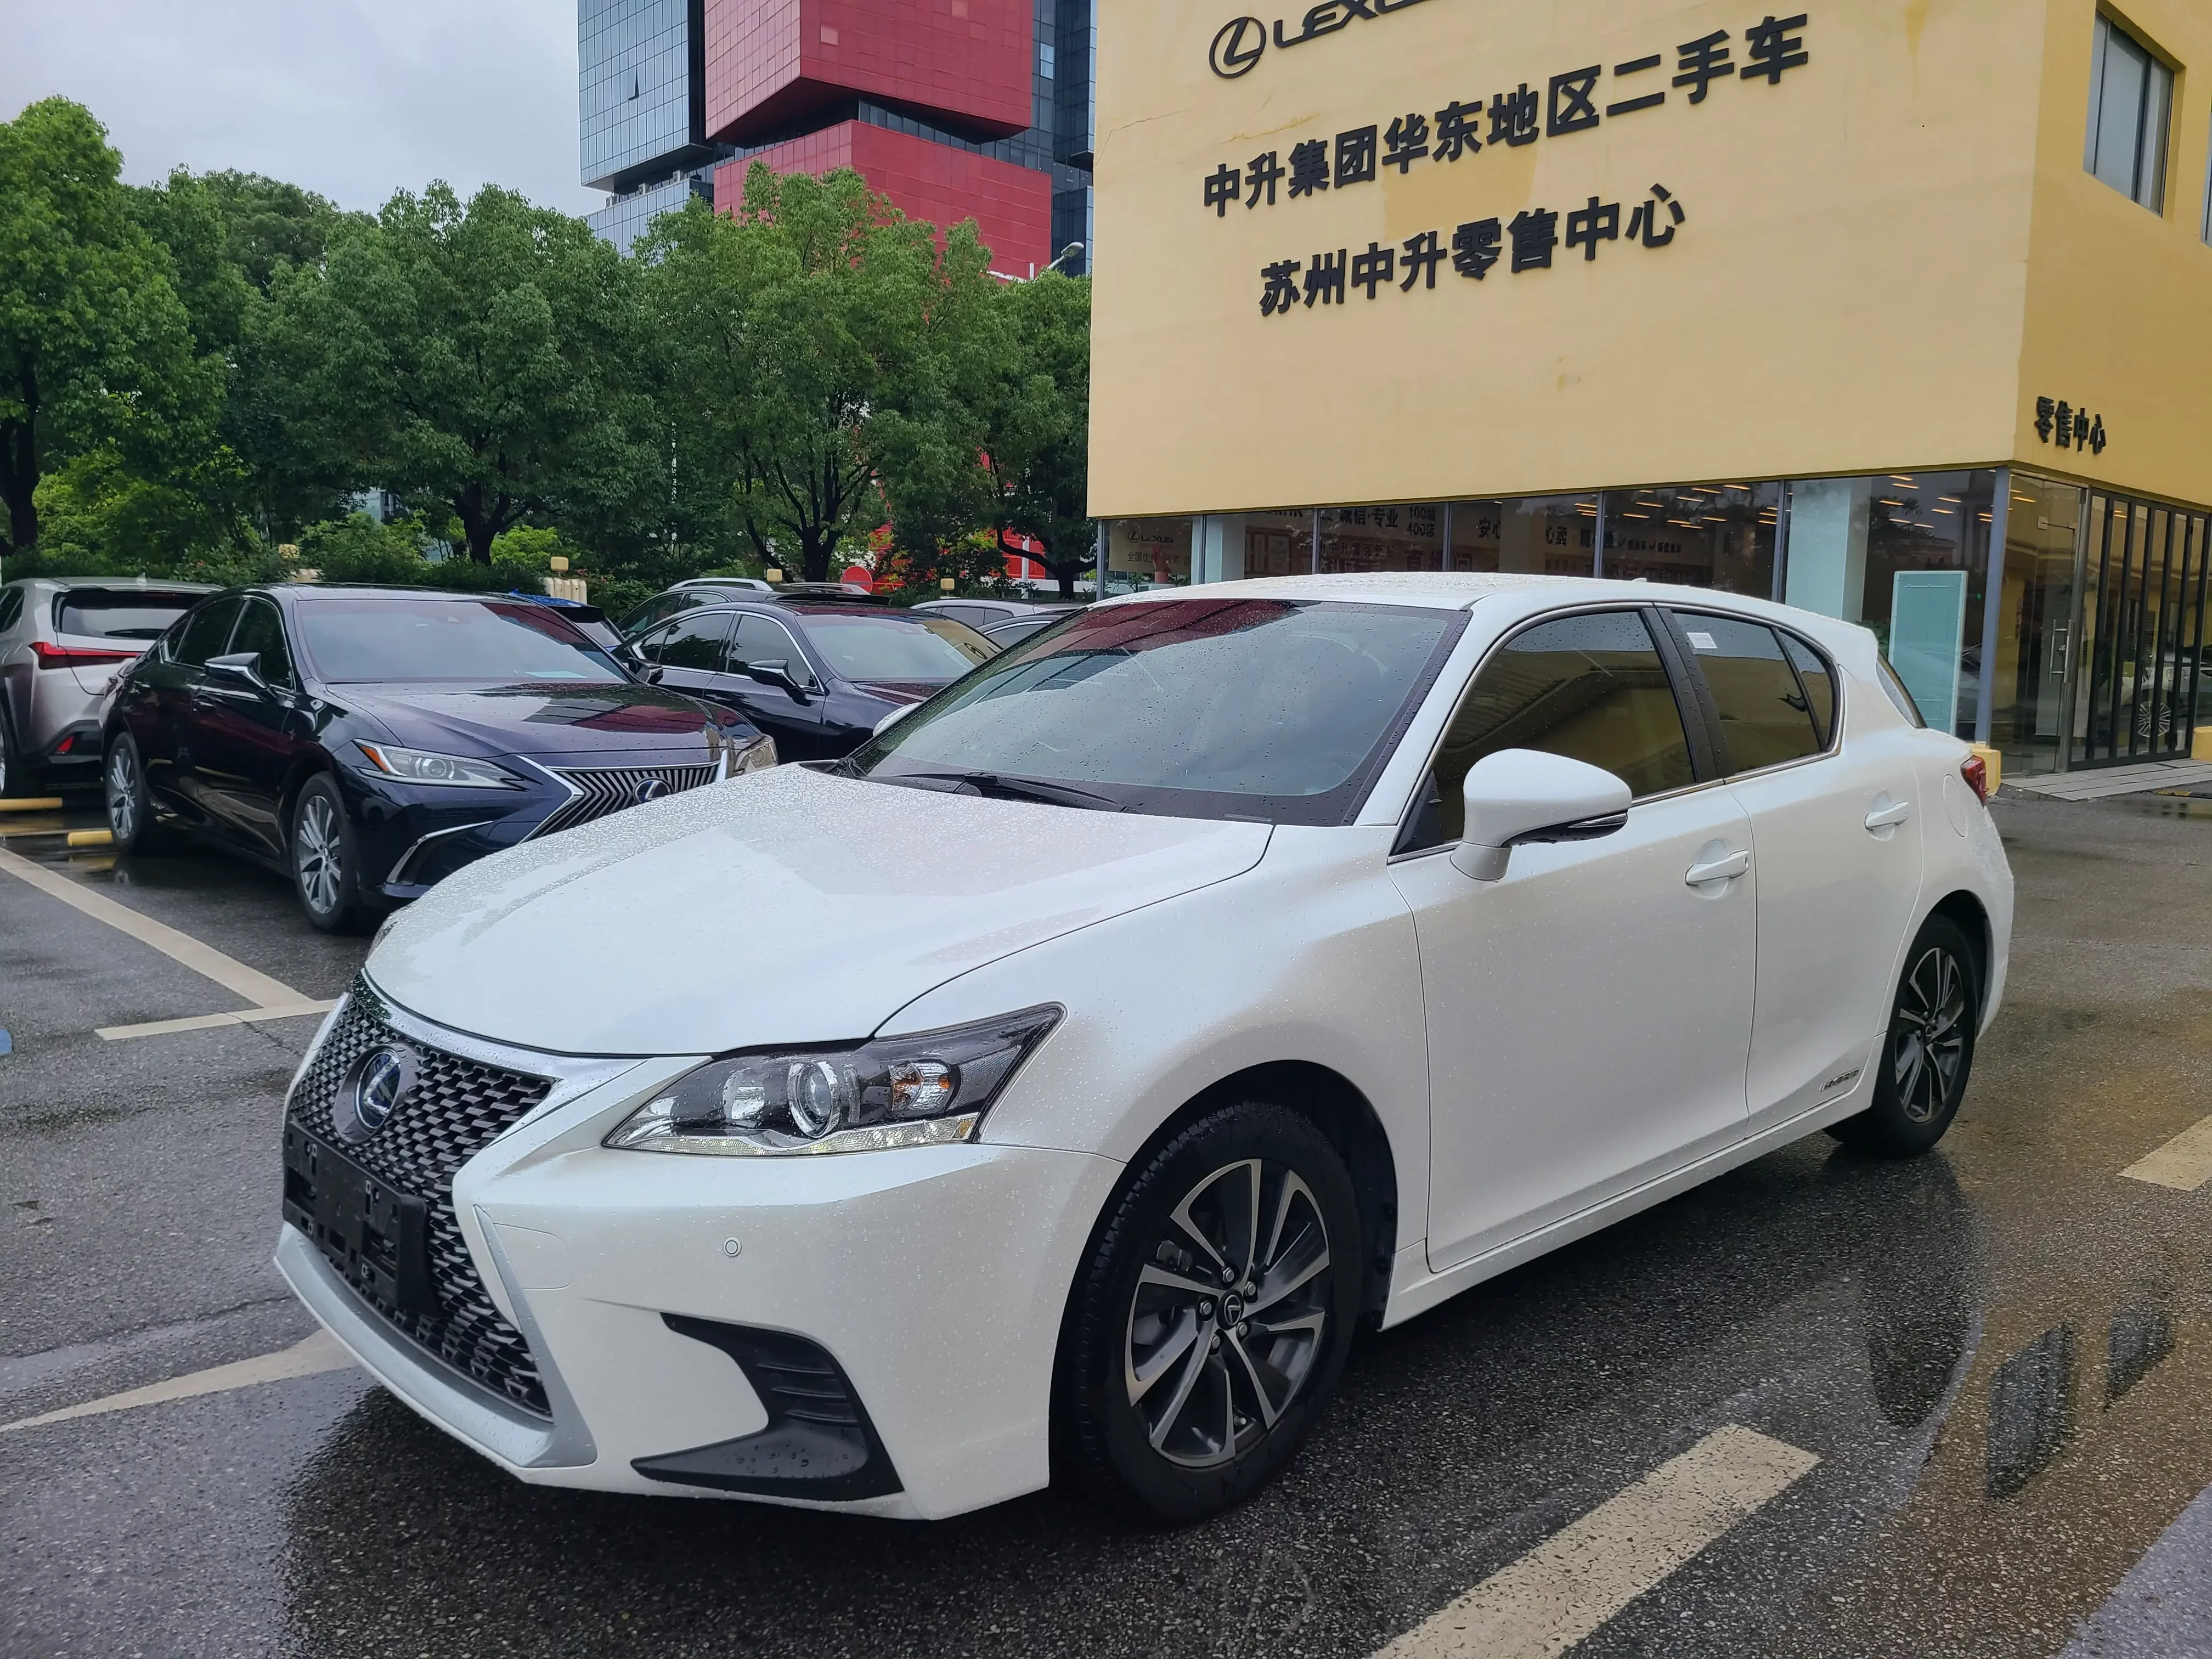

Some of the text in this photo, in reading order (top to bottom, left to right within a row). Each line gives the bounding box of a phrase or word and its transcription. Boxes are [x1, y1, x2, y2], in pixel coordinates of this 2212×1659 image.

[1204, 13, 1809, 217] 中升集团华东地区二手车
[1259, 183, 1686, 317] 苏州中升零售中心
[2034, 396, 2107, 455] 零售中心
[1141, 534, 1173, 543] LEXUS
